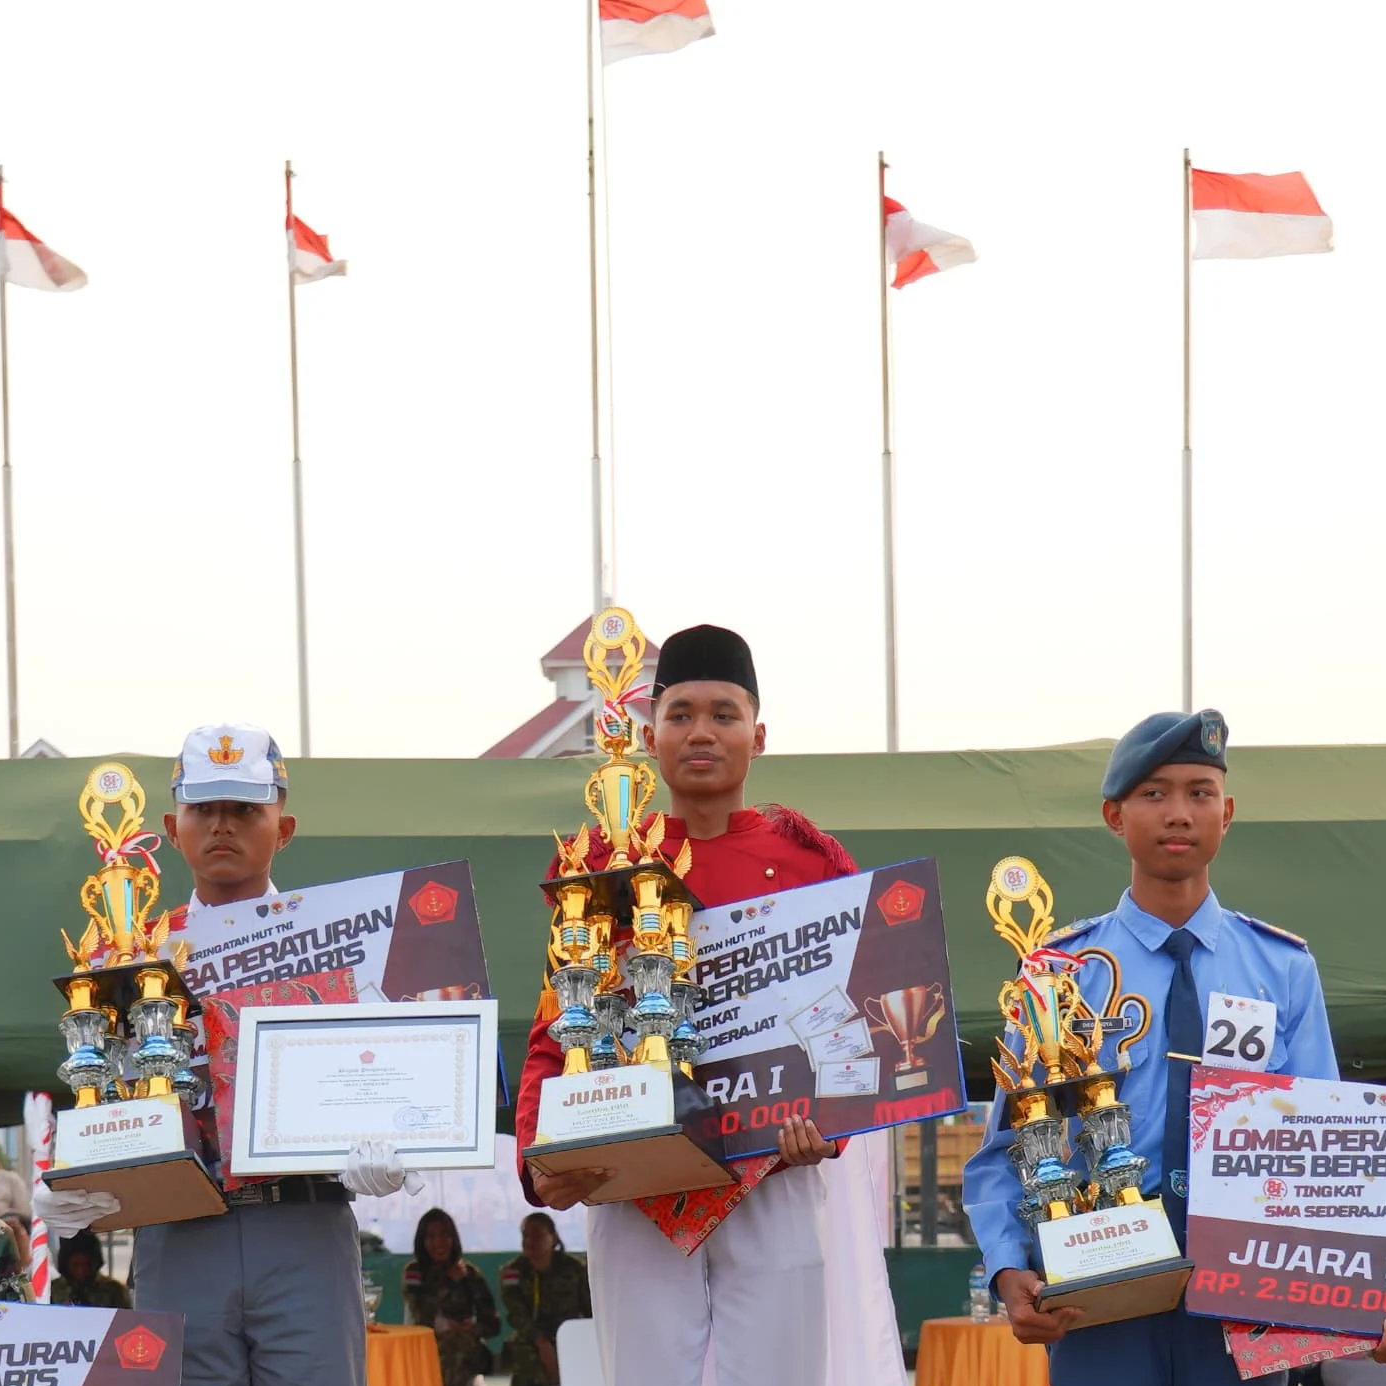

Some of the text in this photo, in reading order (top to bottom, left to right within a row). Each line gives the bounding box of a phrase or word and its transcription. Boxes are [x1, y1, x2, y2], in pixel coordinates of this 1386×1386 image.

[188, 921, 294, 963] ERINGATAN HUT TNI
[222, 905, 393, 980] PERATURAN
[695, 907, 861, 985] PERATURAN
[724, 925, 766, 948] HUT TNI
[694, 1006, 741, 1032] NGKAT
[708, 1015, 778, 1050] DERAJAT
[1206, 1019, 1265, 1062] 26
[563, 1084, 633, 1107] JUARA
[79, 1114, 163, 1137] JUARA 2
[1282, 1115, 1353, 1125] PERINGATAN
[1355, 1116, 1377, 1124] HUT
[1213, 1128, 1317, 1151] LOMBA
[1212, 1154, 1306, 1177] BARIS
[1294, 1185, 1365, 1198] TINGKAT
[1264, 1205, 1301, 1218] SMA
[1064, 1219, 1150, 1248] JUARA 3
[1228, 1239, 1373, 1280] JUARA
[1194, 1269, 1246, 1297] RP.
